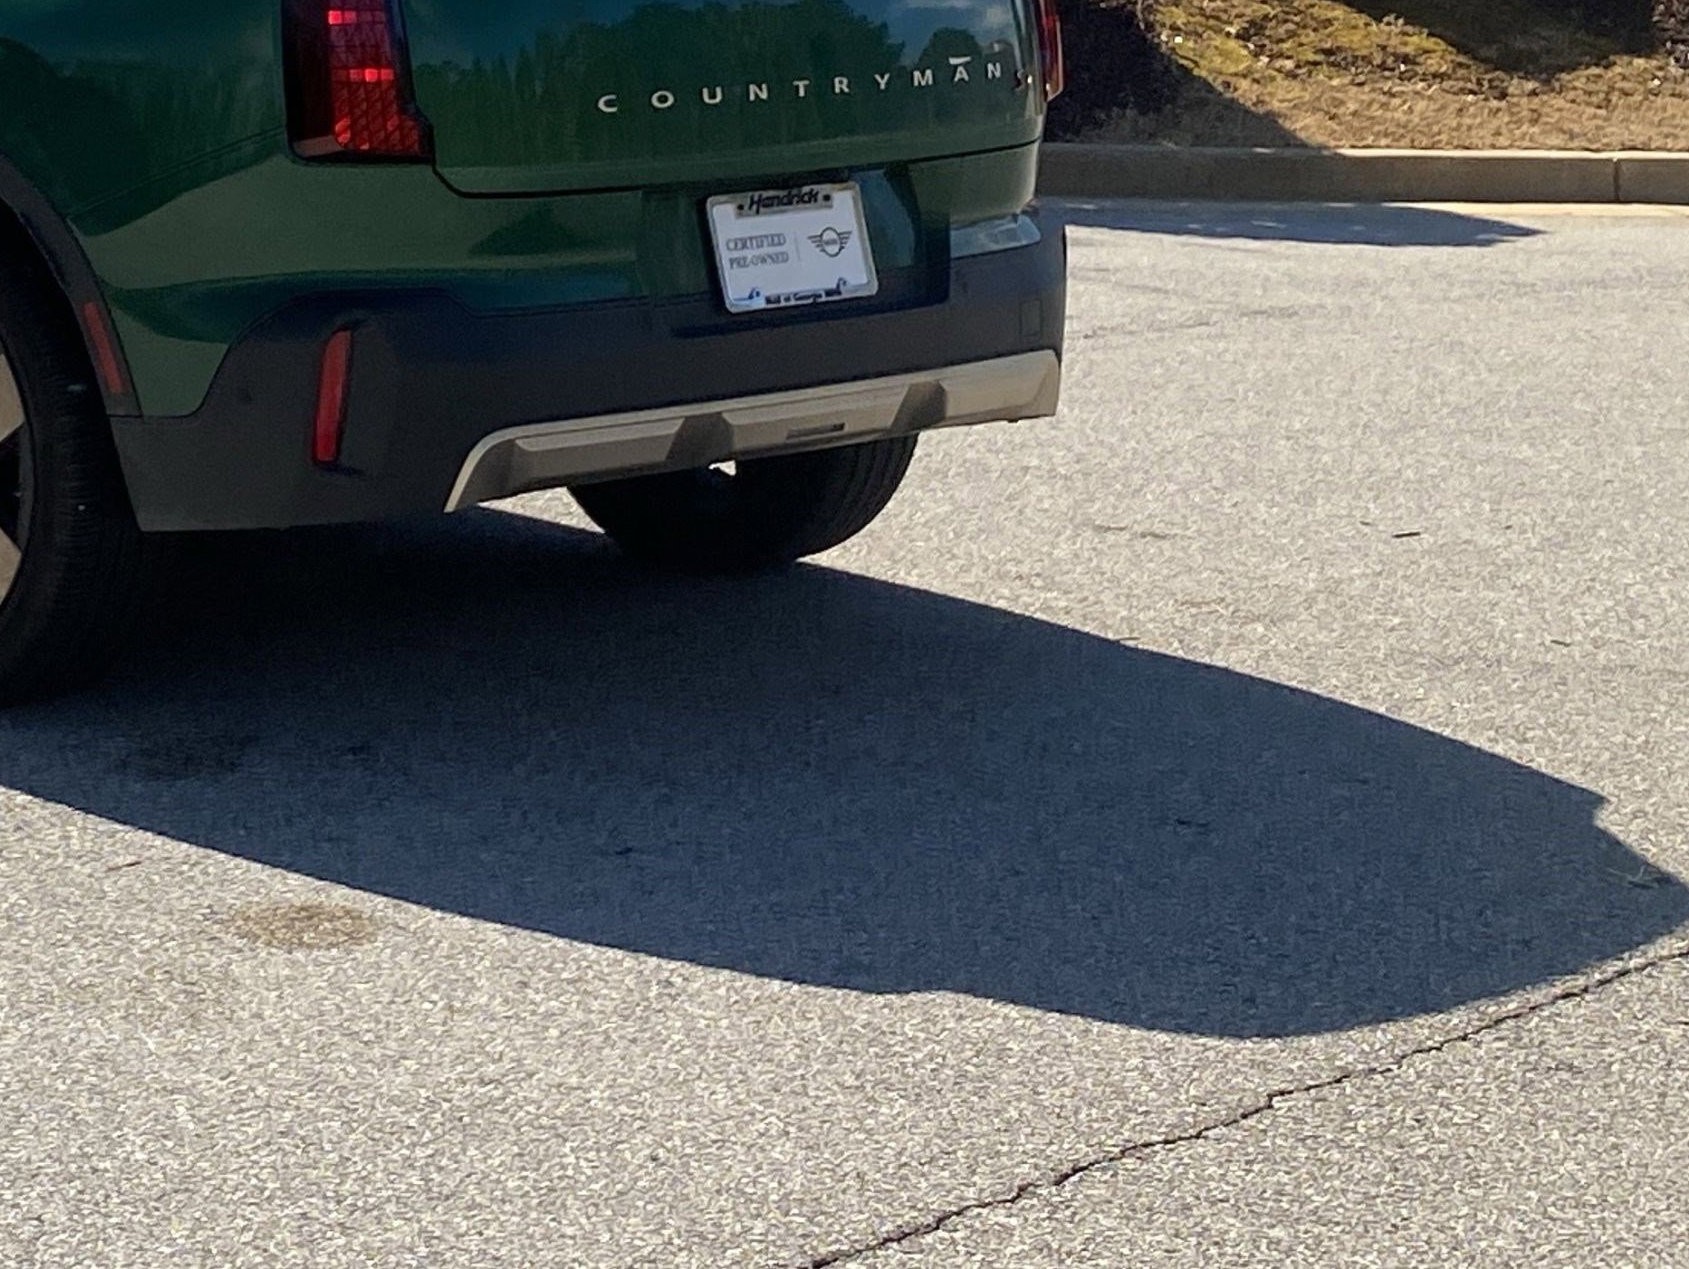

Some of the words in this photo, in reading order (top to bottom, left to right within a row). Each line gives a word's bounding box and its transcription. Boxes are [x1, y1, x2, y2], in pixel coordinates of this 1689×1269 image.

[597, 58, 1002, 114] COUNTRYMAN
[748, 188, 819, 215] Hendrick
[725, 233, 787, 251] CERTIFIED
[729, 251, 789, 270] PRE-OWNED
